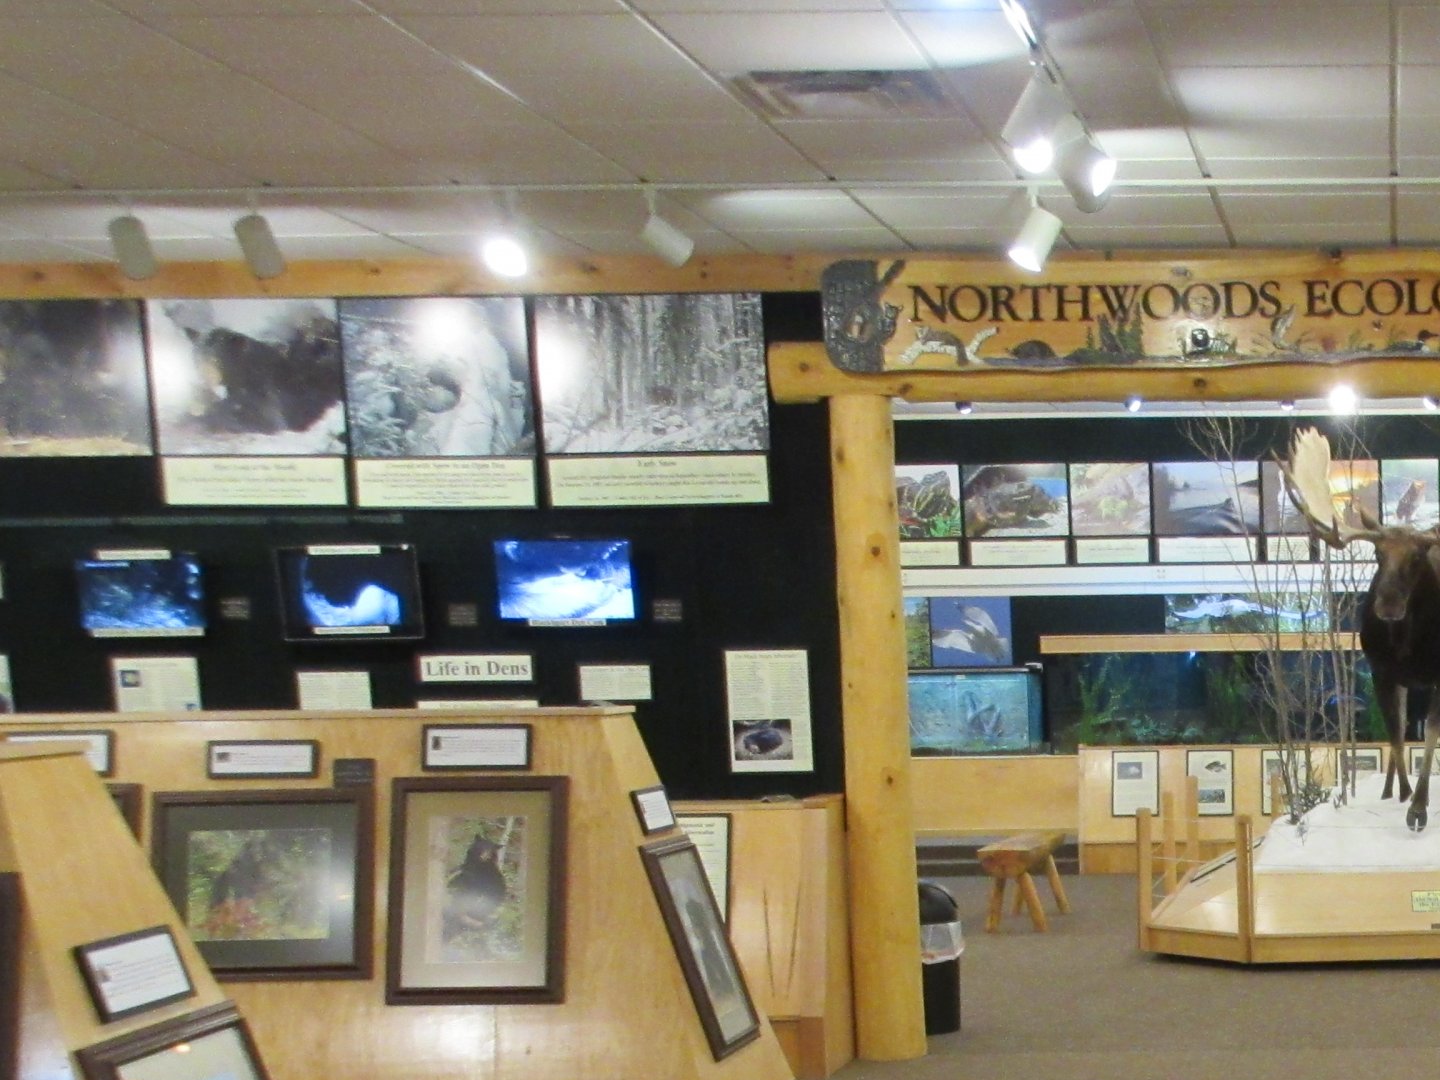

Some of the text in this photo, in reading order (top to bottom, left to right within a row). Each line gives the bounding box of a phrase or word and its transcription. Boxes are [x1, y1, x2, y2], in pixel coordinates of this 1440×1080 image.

[907, 280, 1282, 323] NORTHWOODS
[425, 660, 529, 676] Life in Dens
